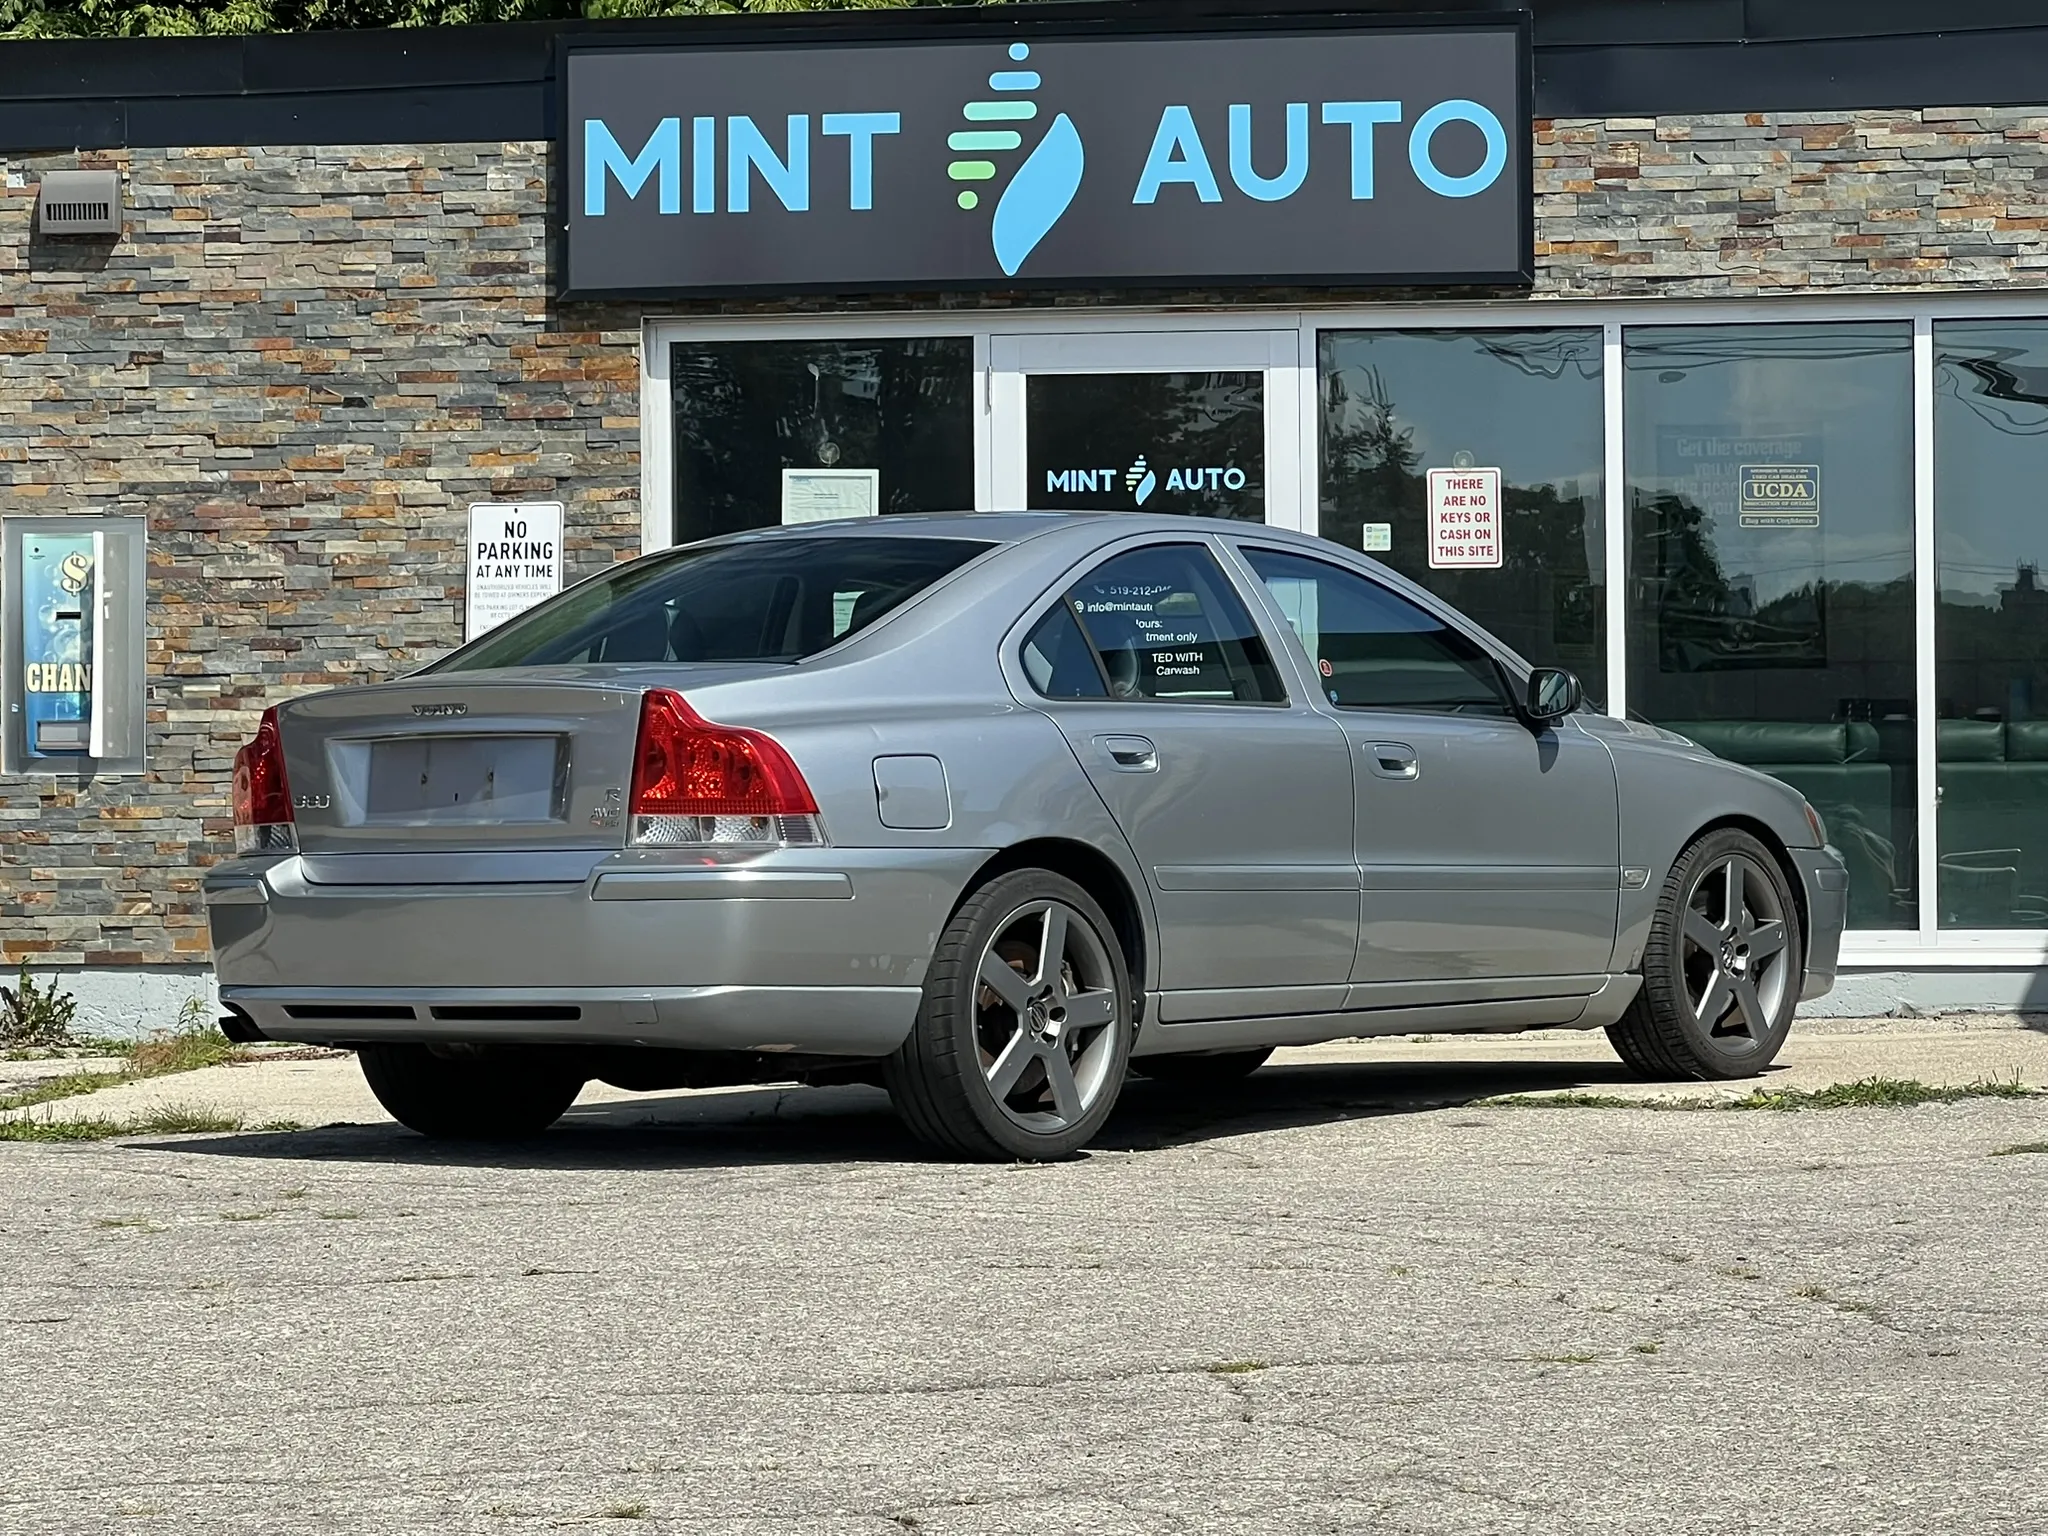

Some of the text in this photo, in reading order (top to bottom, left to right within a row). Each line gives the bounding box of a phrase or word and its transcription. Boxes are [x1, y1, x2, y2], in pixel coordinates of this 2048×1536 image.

[583, 98, 1508, 216] MINT AUTO
[1734, 440, 1802, 459] coverage
[1046, 467, 1246, 493] MINT AUTO
[1445, 478, 1484, 490] THERE
[1752, 482, 1808, 498] UCDA
[1443, 495, 1487, 507] ARE NO
[1440, 512, 1491, 524] KEYS OR
[504, 521, 527, 538] NO
[1440, 529, 1492, 540] CASH ON
[477, 541, 553, 560] PARKING
[1438, 546, 1494, 557] THIS SITE
[476, 564, 553, 578] AT ANY TIME
[1176, 632, 1198, 643] only
[1175, 652, 1204, 662] WITH
[1156, 666, 1201, 676] Carwash
